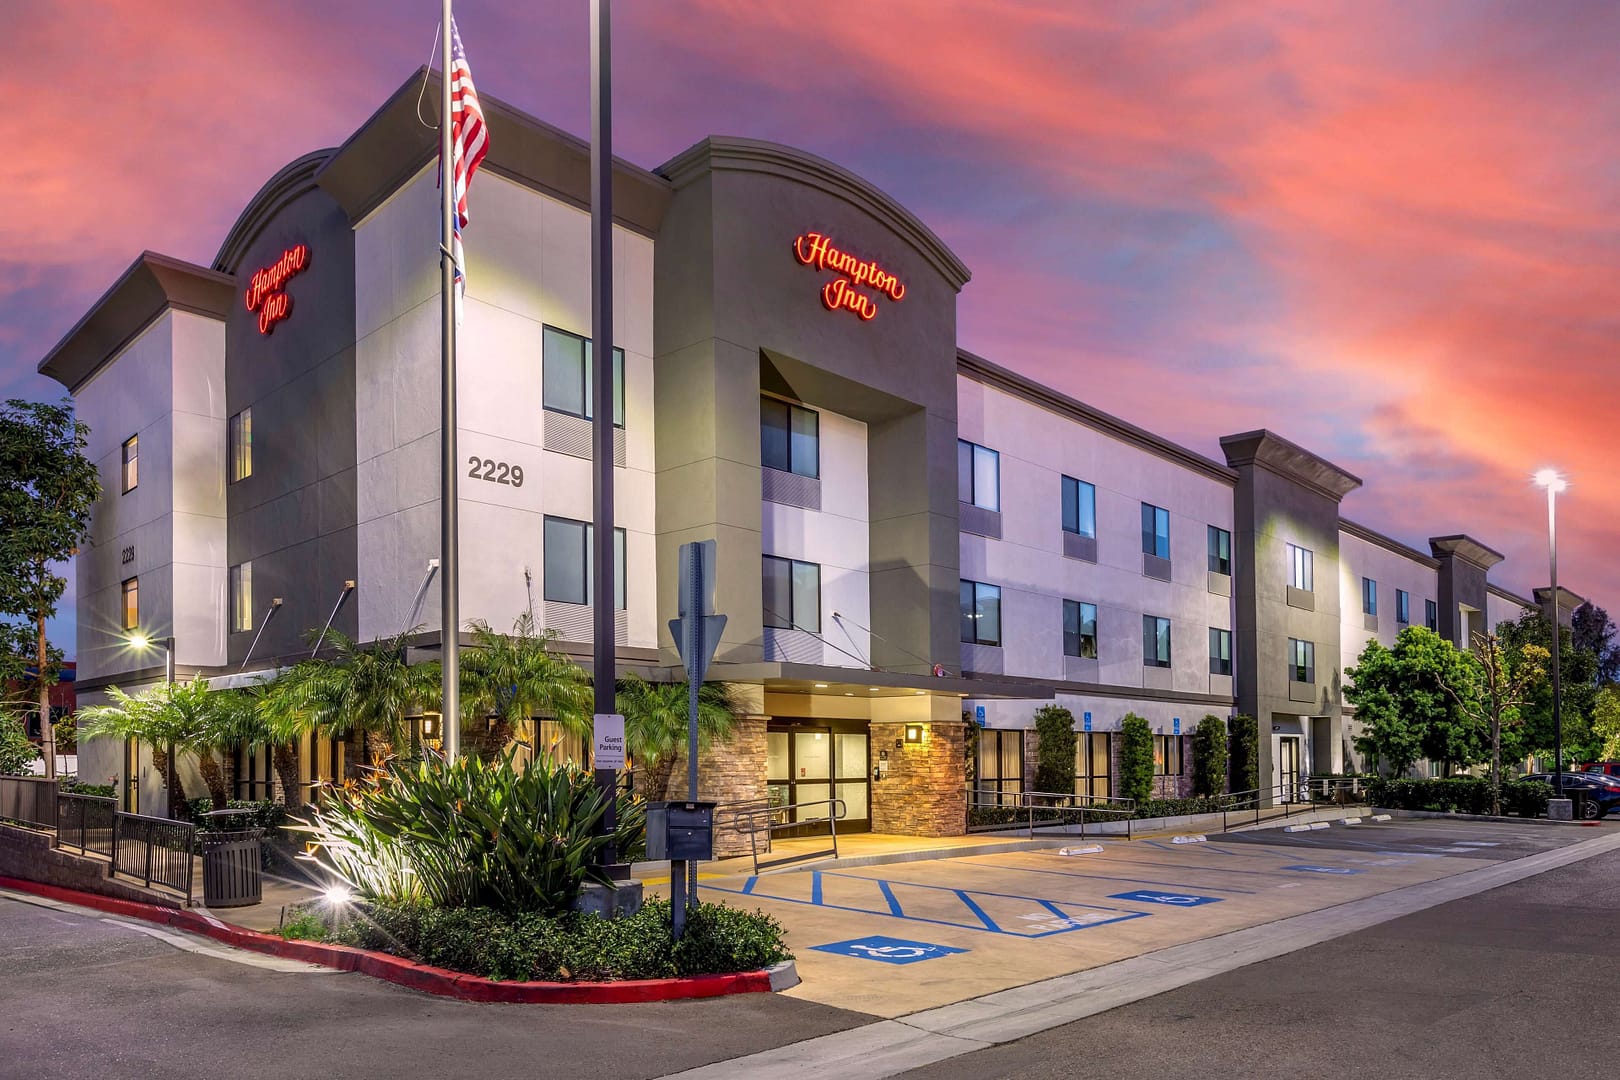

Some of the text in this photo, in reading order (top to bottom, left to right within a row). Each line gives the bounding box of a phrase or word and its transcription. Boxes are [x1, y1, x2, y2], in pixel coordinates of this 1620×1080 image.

[245, 244, 306, 311] Hampton
[796, 232, 906, 301] Hampton
[259, 293, 288, 334] Inn
[824, 279, 877, 320] Inn
[468, 455, 524, 488] 2229
[121, 545, 135, 565] 2229
[599, 743, 622, 753] Parking
[604, 735, 622, 743] Guest
